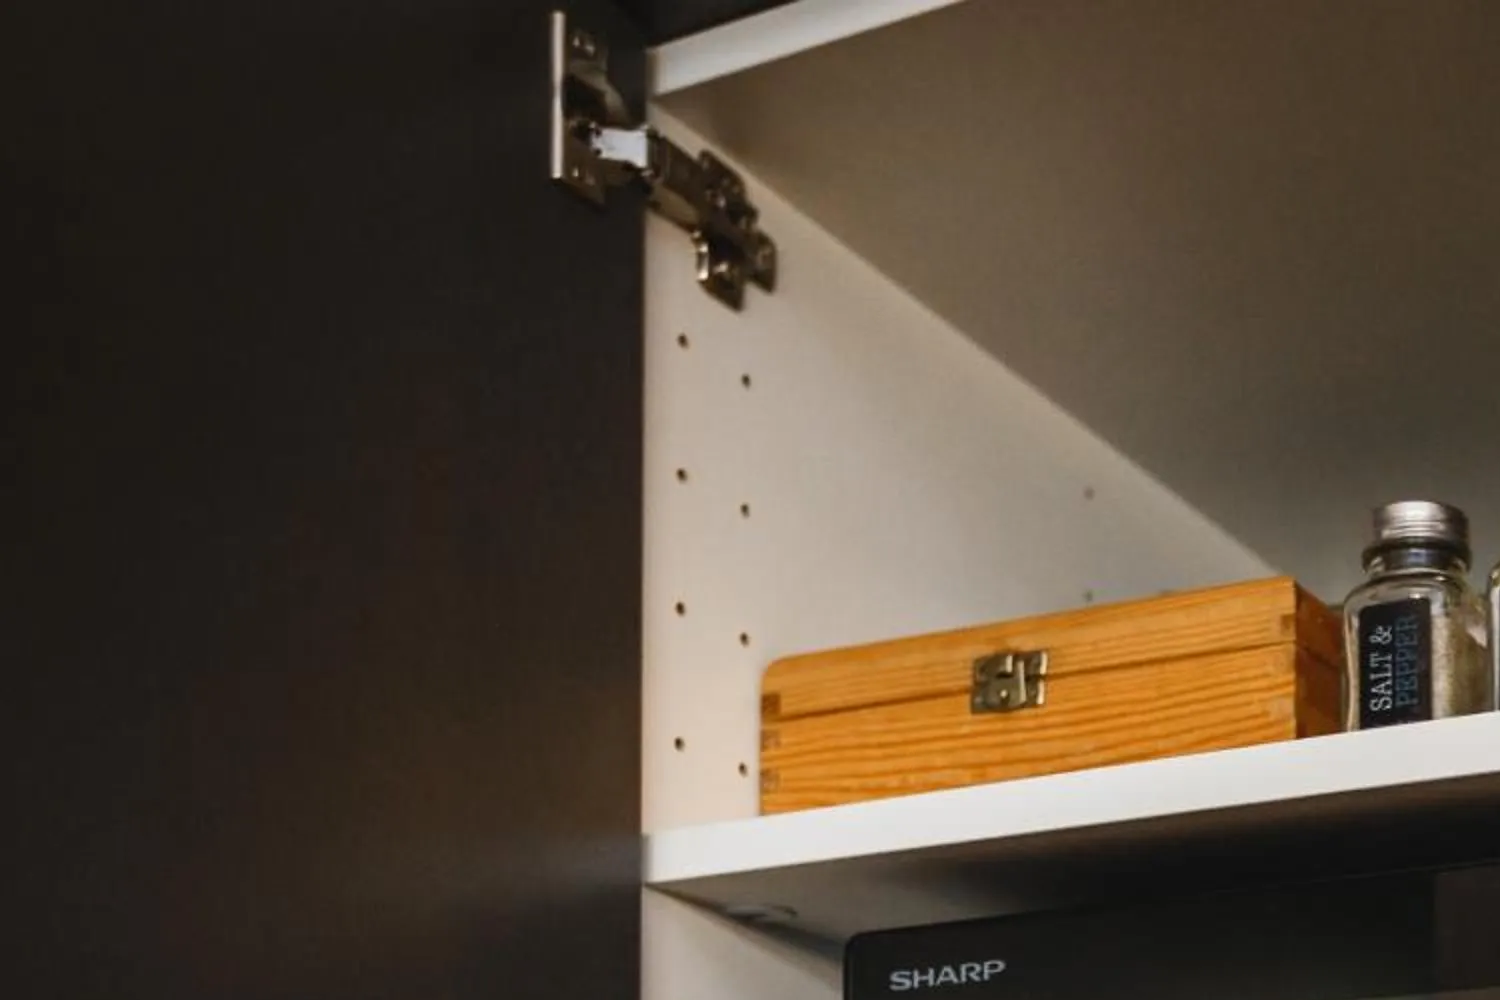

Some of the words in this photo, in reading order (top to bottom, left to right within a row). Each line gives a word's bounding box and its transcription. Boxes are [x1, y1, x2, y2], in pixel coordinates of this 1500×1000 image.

[1369, 625, 1393, 645] &
[1369, 652, 1393, 711] SALT
[1395, 616, 1419, 707] PEPPER
[889, 959, 1006, 991] SHARP
